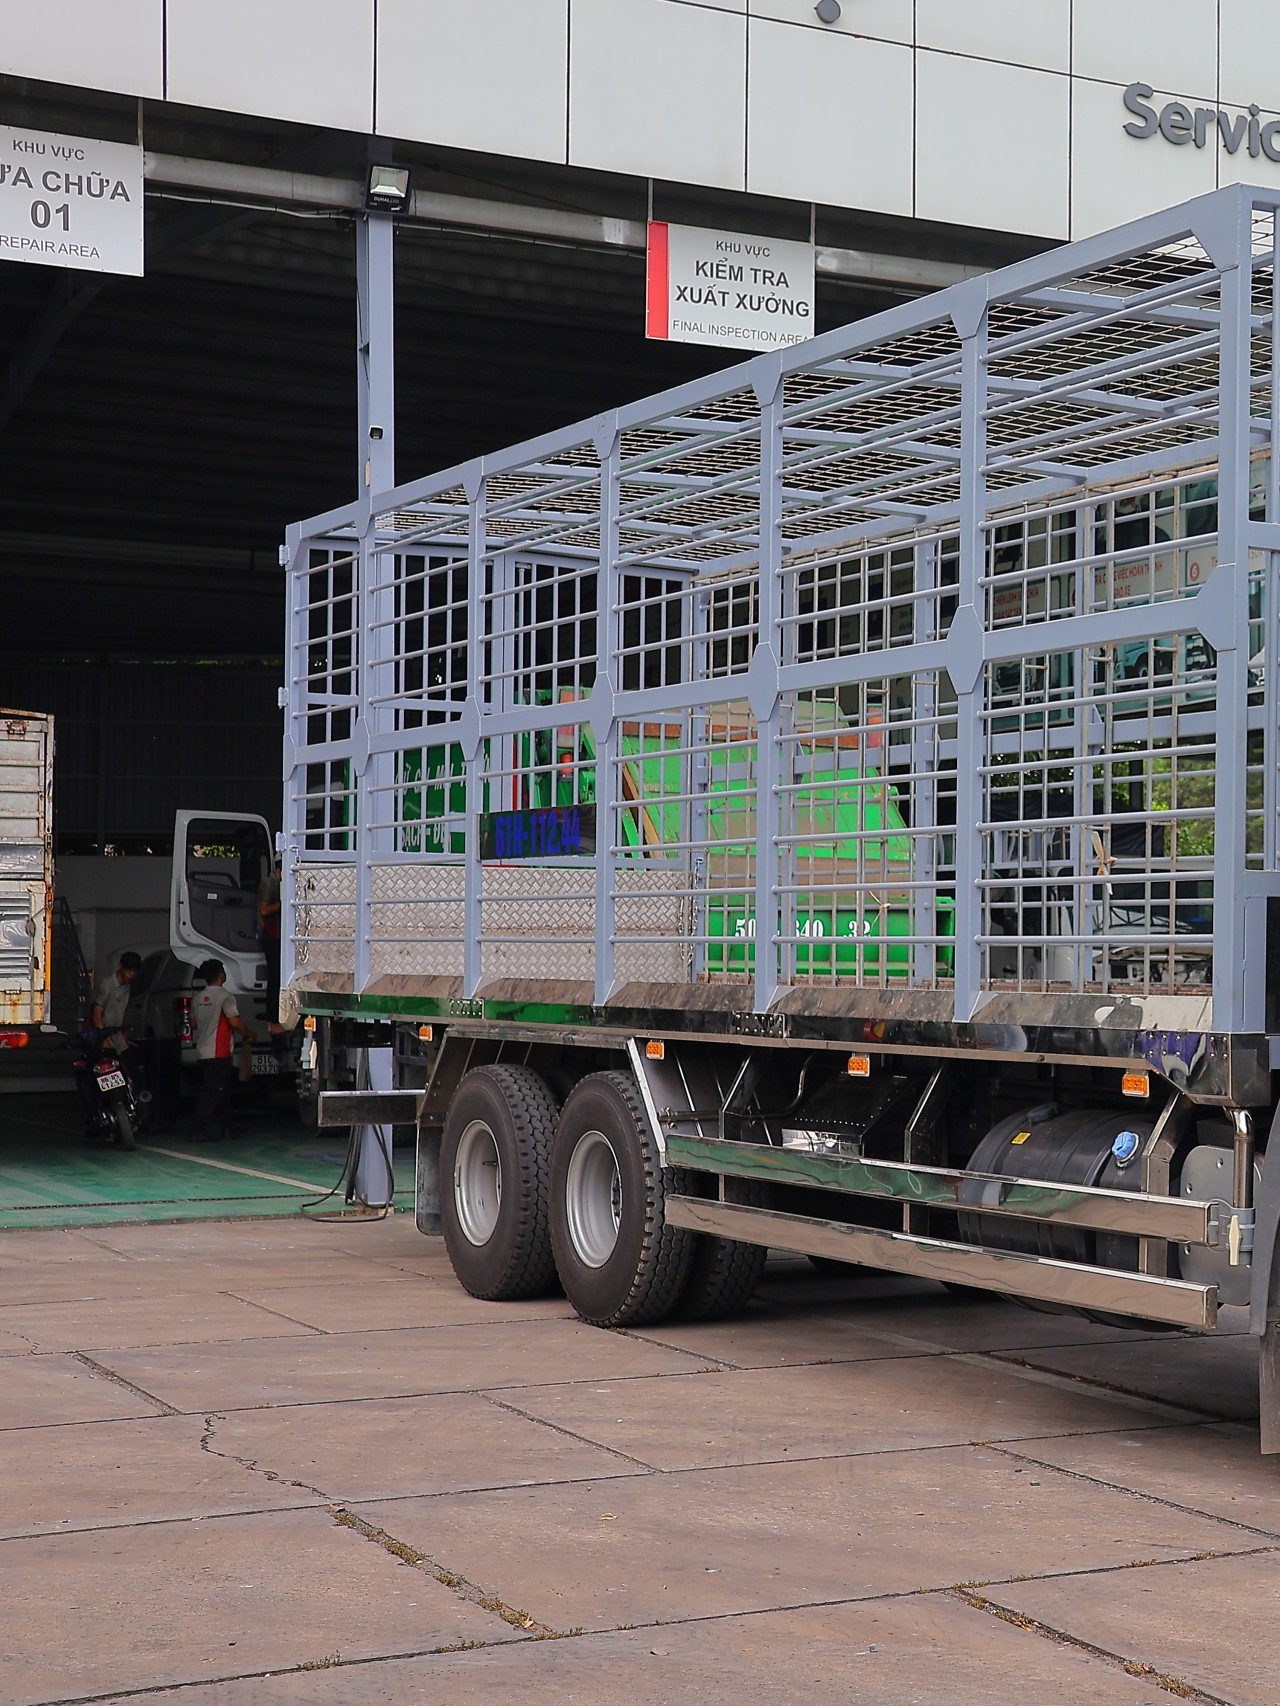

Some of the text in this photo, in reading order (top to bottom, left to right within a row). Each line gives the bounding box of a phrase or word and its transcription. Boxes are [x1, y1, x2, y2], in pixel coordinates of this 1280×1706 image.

[13, 139, 85, 161] KHU VỰC
[42, 171, 131, 203] CHỮA
[30, 200, 70, 232] 01
[0, 235, 100, 258] REPAIR AREA
[716, 241, 771, 258] KHU VỰC
[695, 257, 789, 288] KIỂM TRA
[676, 284, 810, 317] XUẤT XƯỞNG
[673, 320, 706, 334] FINAL
[708, 324, 777, 343] INSPECTION
